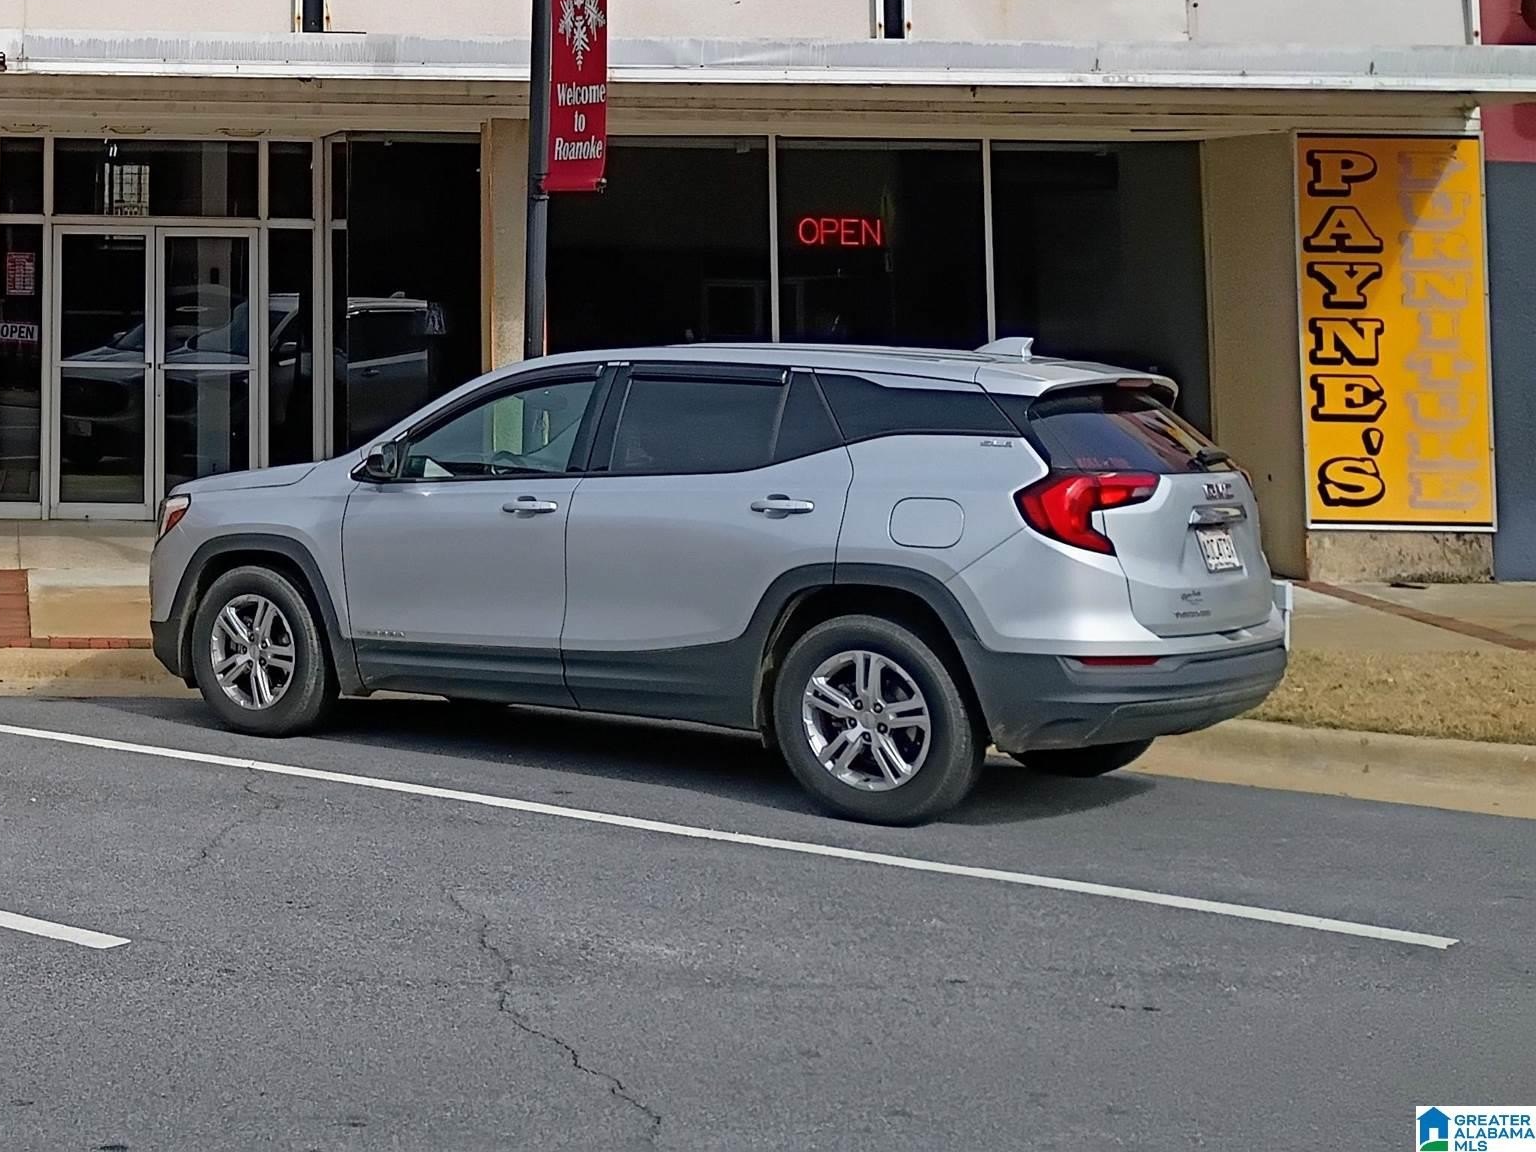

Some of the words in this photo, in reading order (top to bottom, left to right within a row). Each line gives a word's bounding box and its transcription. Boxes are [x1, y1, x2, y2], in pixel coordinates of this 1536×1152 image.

[557, 81, 606, 106] Welcome
[574, 110, 585, 132] to
[554, 135, 603, 160] Roanoke
[798, 217, 881, 246] OPEN
[0, 324, 35, 339] OPEN
[1303, 149, 1387, 508] PAYNE'S
